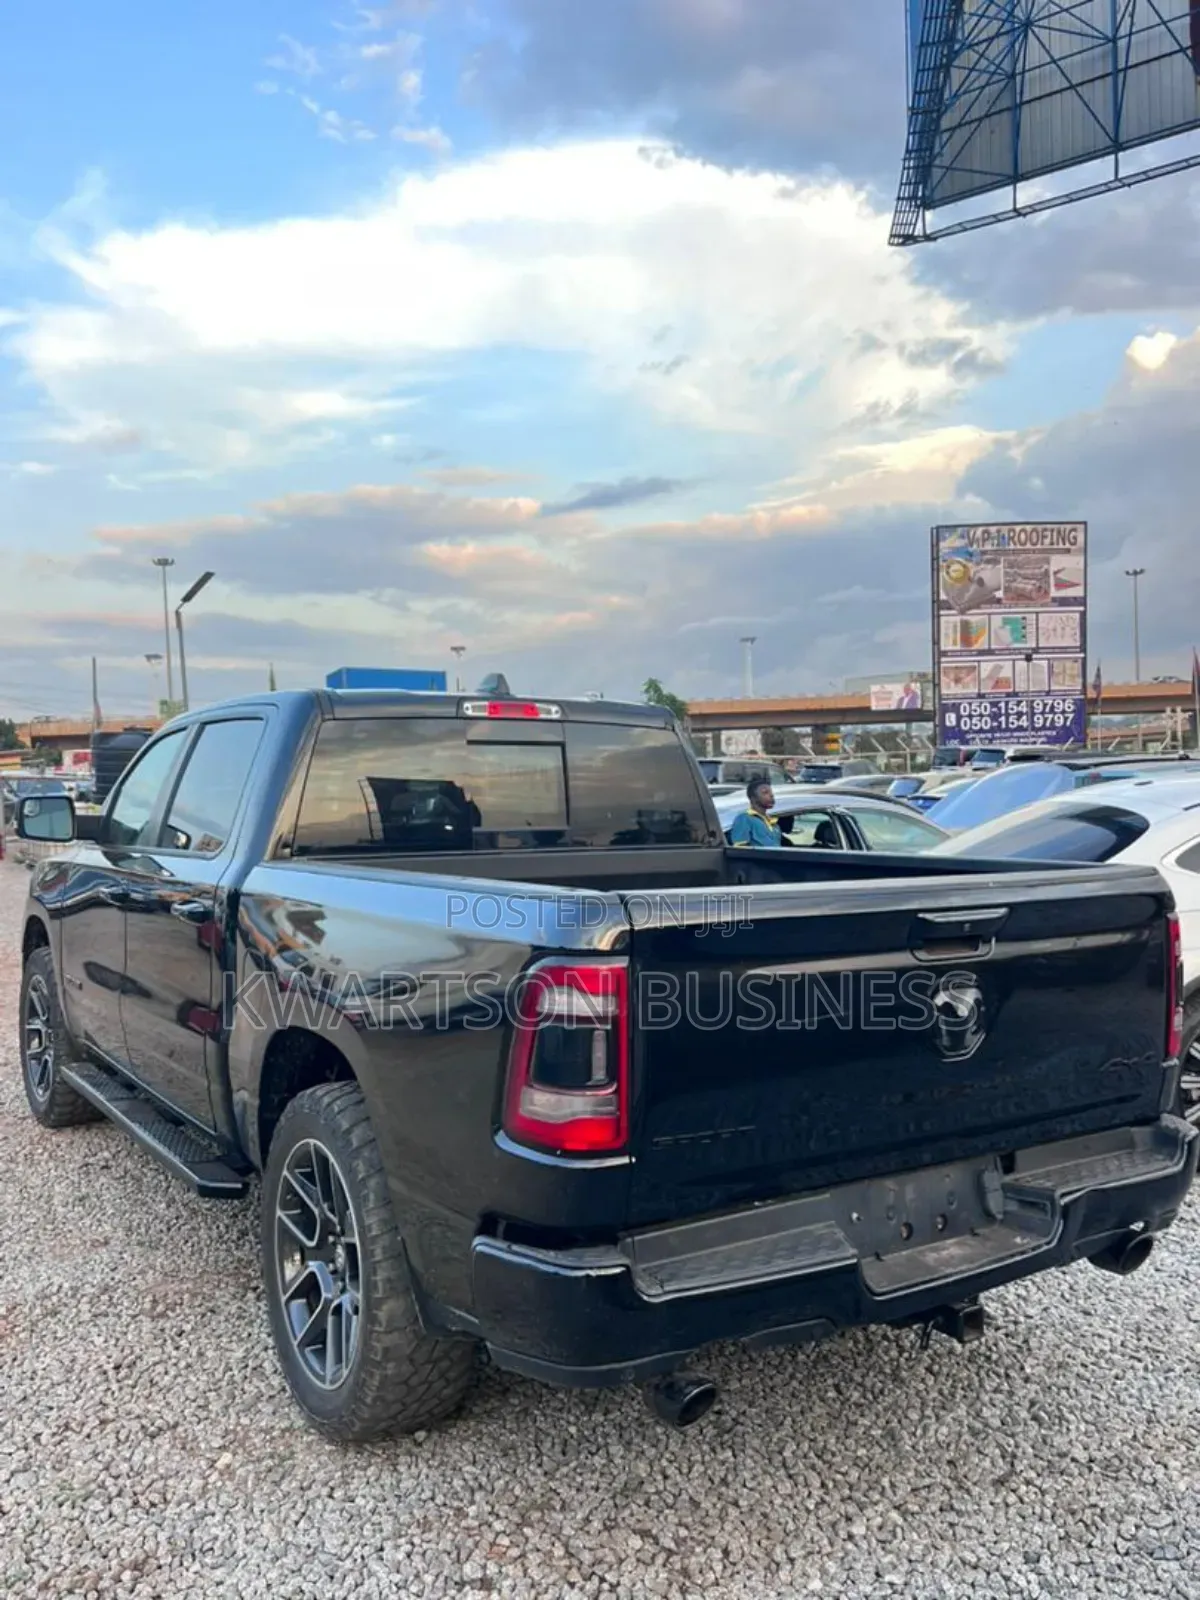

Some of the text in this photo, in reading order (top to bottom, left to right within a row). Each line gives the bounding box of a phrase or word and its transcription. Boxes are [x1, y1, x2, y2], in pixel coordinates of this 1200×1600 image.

[1007, 527, 1078, 547] ROOFING
[960, 699, 1075, 716] 050-154 9796
[960, 713, 1075, 730] 050-154 9797
